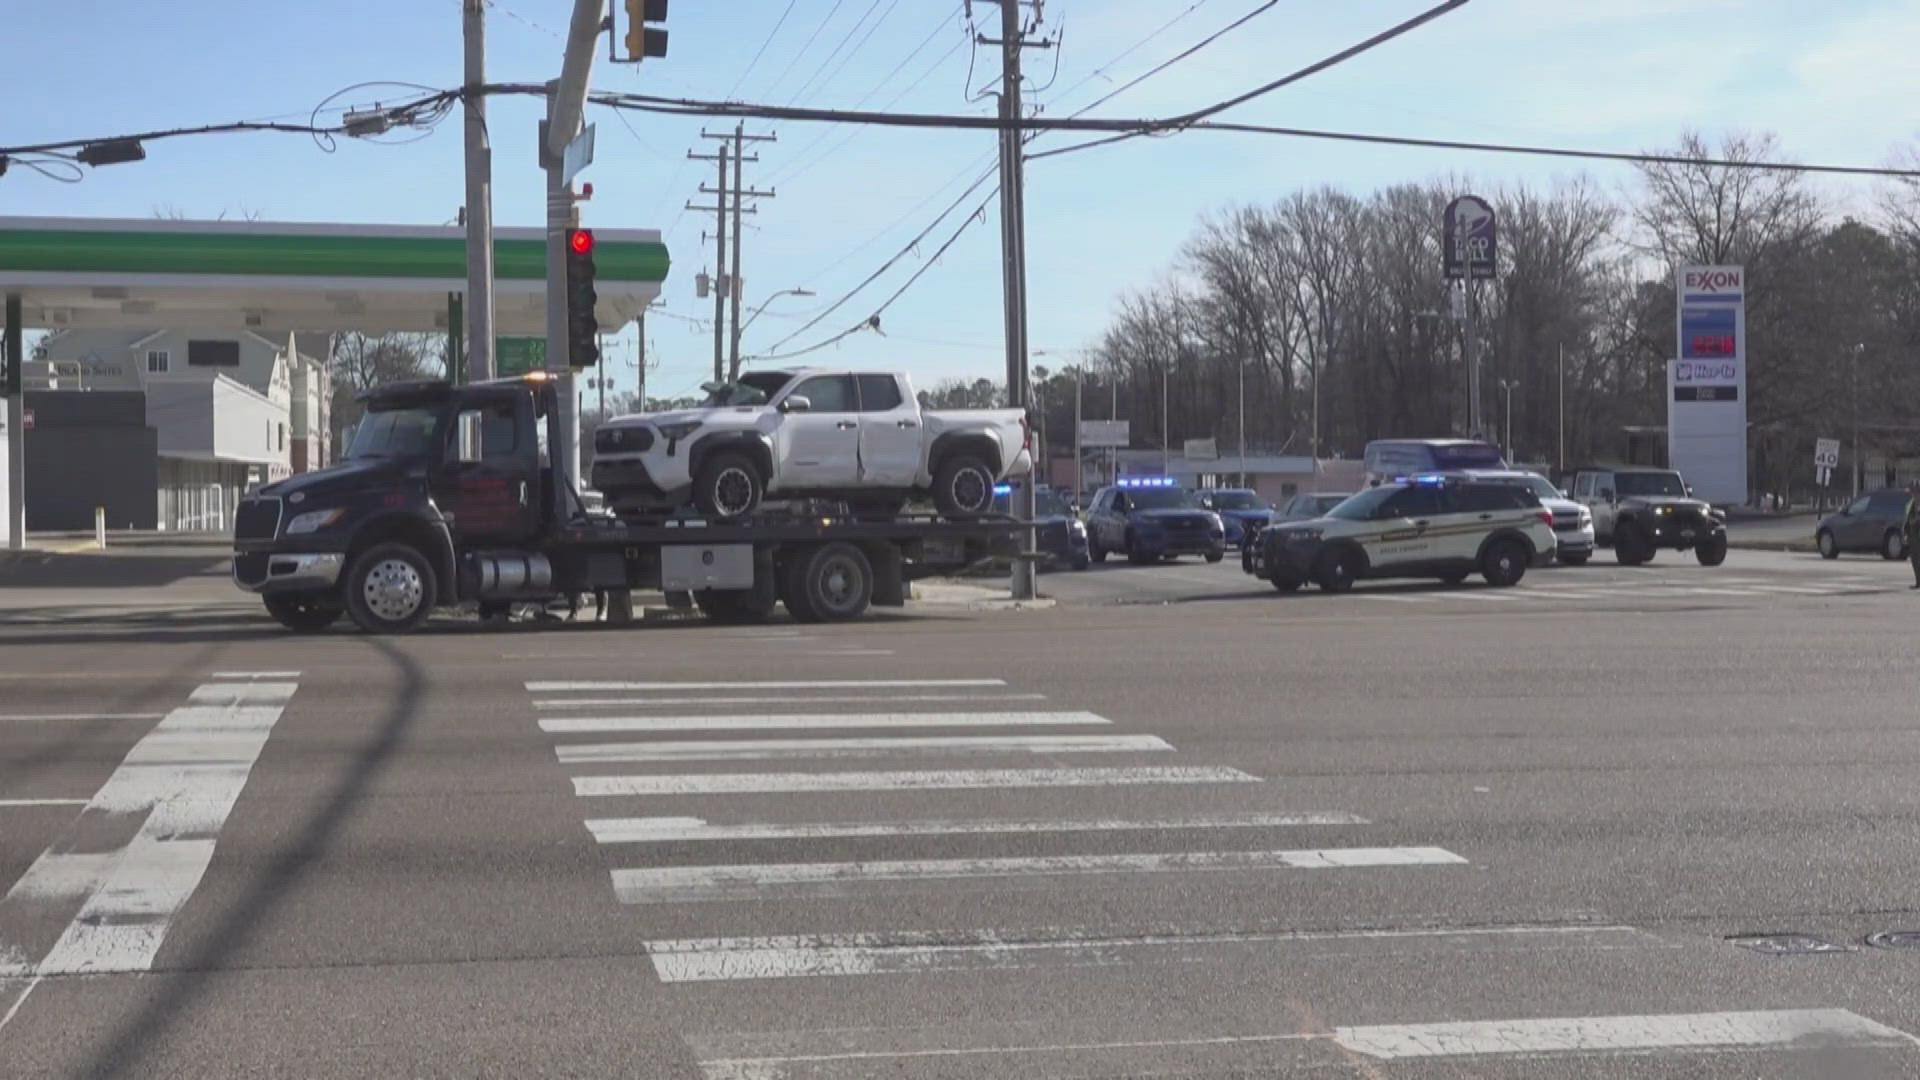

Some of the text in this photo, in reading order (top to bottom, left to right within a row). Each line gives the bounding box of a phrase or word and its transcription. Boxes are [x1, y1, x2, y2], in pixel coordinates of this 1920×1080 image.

[1455, 249, 1489, 261] BLL
[1685, 270, 1740, 292] EXXON
[1816, 453, 1837, 464] 40
